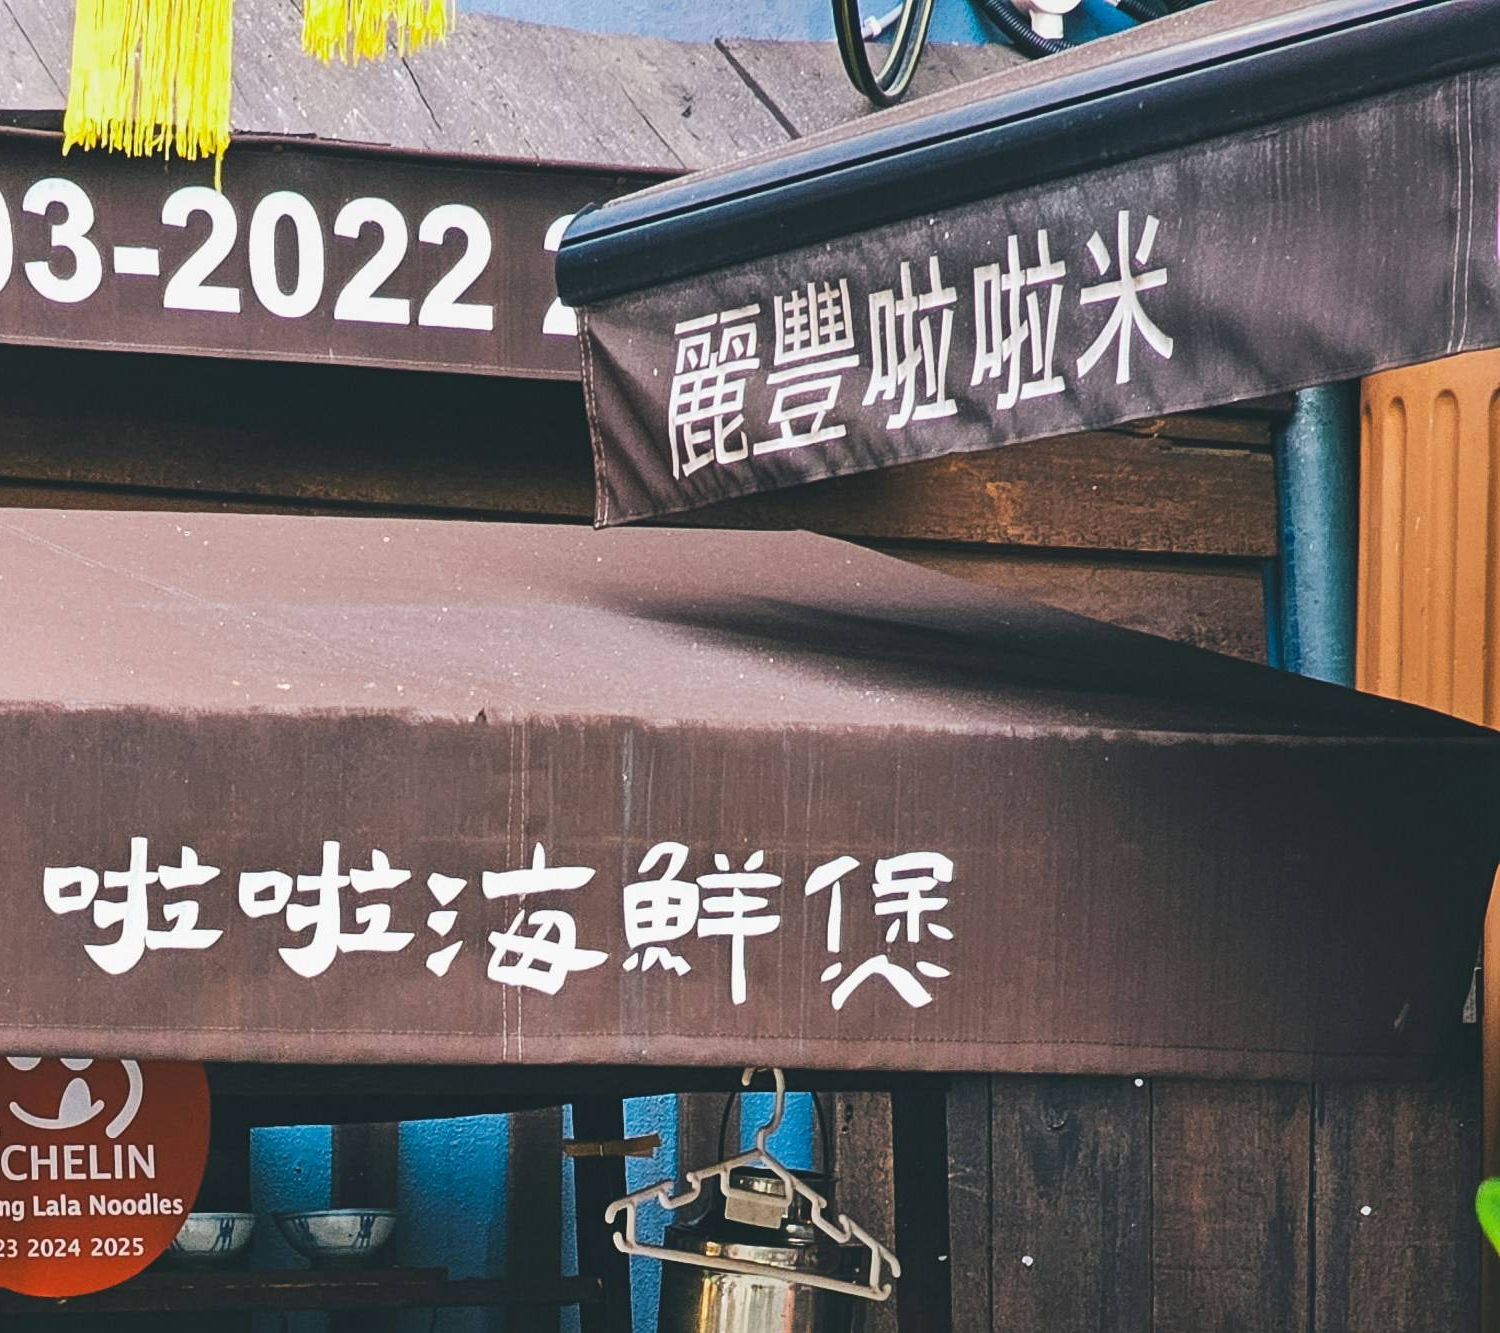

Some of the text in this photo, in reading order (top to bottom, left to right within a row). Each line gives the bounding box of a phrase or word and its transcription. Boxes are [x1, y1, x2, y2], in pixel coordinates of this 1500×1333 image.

[668, 208, 1174, 481] 麗豐啦啦米
[43, 836, 954, 1010] 啦啦海鮮煲
[27, 1238, 81, 1258] 2024
[90, 1237, 145, 1257] 2025
[32, 1193, 80, 1217] Lala
[89, 1192, 184, 1217] Noodles
